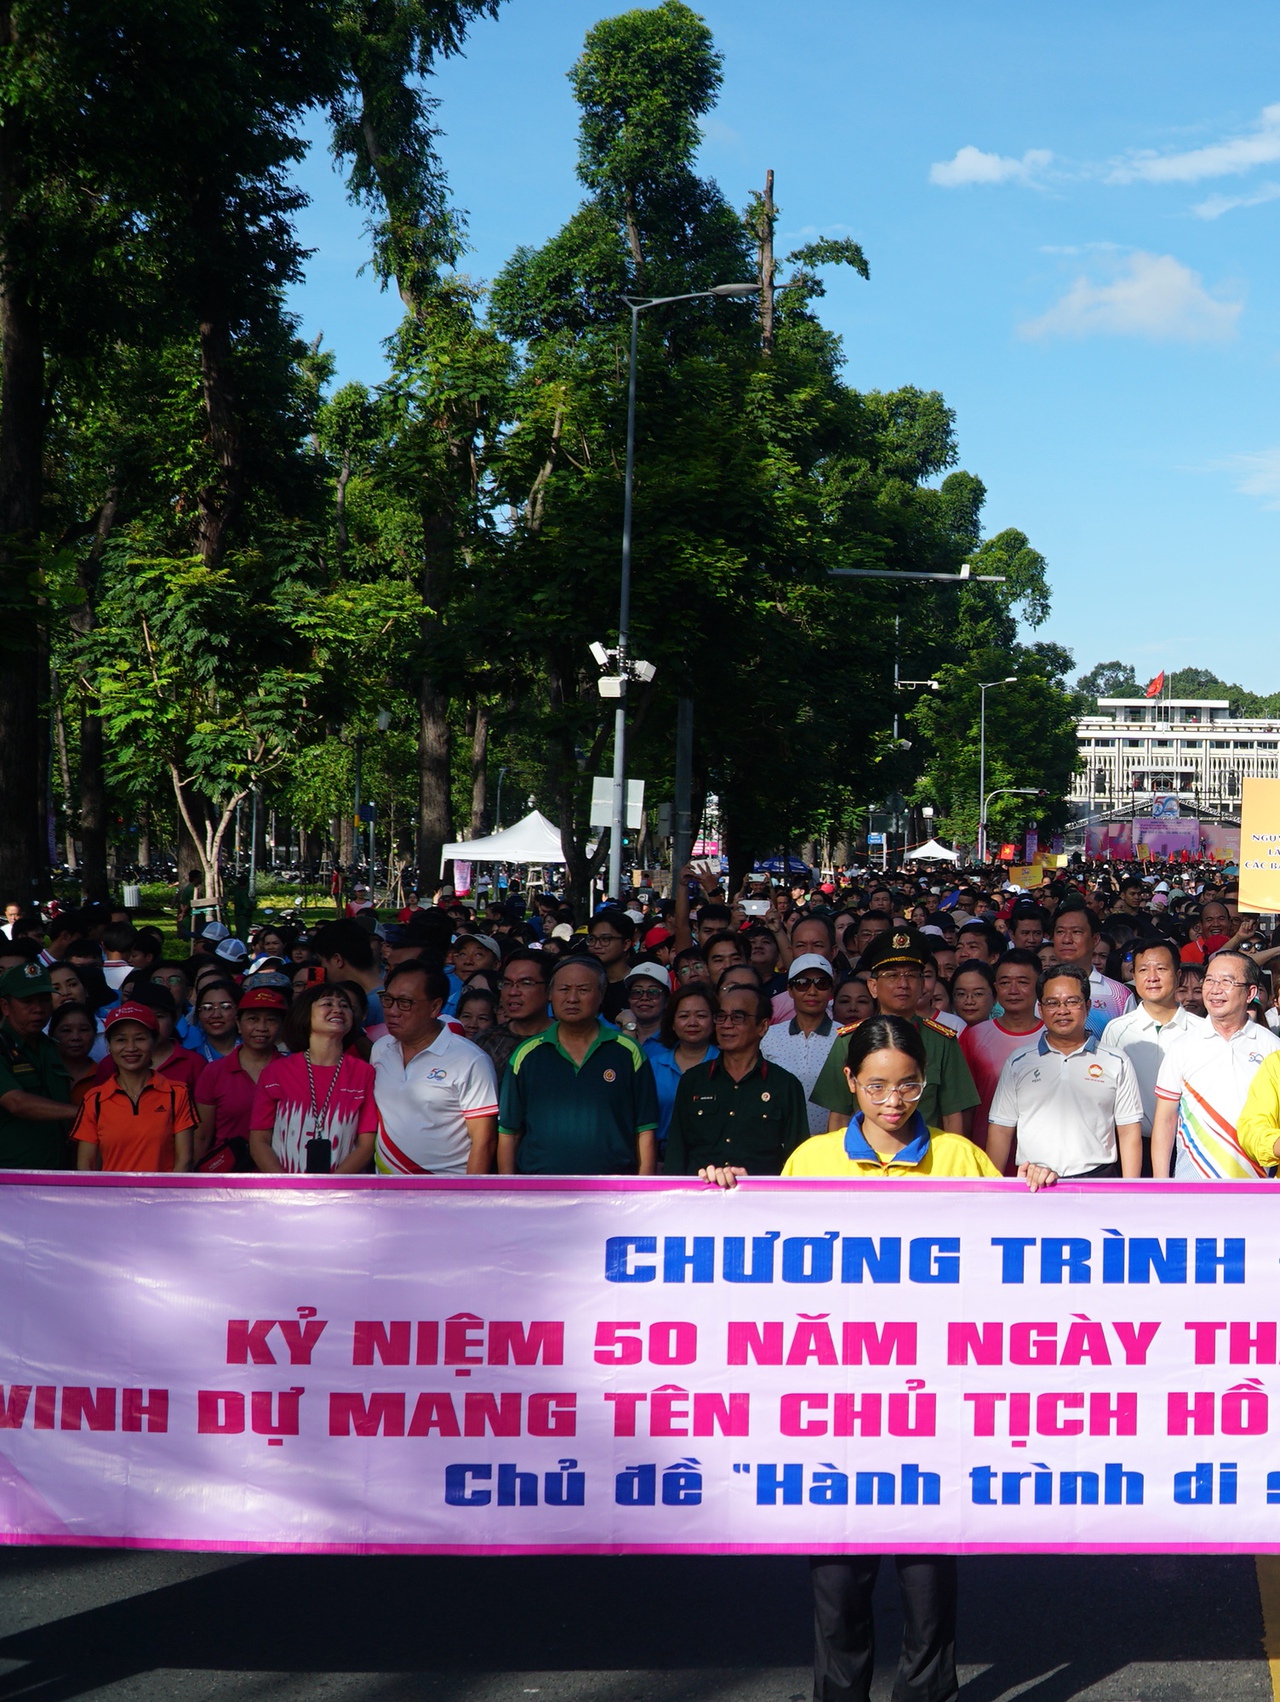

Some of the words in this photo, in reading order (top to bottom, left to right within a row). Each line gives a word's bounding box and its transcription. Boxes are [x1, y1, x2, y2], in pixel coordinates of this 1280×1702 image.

[607, 1231, 961, 1284] CHƯƠNG
[992, 1229, 1246, 1284] TRÌNH
[226, 1307, 328, 1365] KỶ
[353, 1313, 565, 1377] NIỆM
[594, 1322, 698, 1366] 50
[728, 1314, 918, 1366] NĂM
[948, 1314, 1161, 1366] NGÀY
[0, 1385, 168, 1433] VINH
[198, 1388, 305, 1447] DỰ
[329, 1393, 577, 1438] MANG
[604, 1385, 750, 1438] TÊN
[780, 1379, 937, 1438] CHỦ
[964, 1393, 1138, 1448] TỊCH
[1168, 1378, 1269, 1437] HỒ
[445, 1459, 585, 1507] Chủ
[615, 1458, 703, 1507] đề
[970, 1463, 1144, 1506] trình
[1174, 1463, 1238, 1505] di
